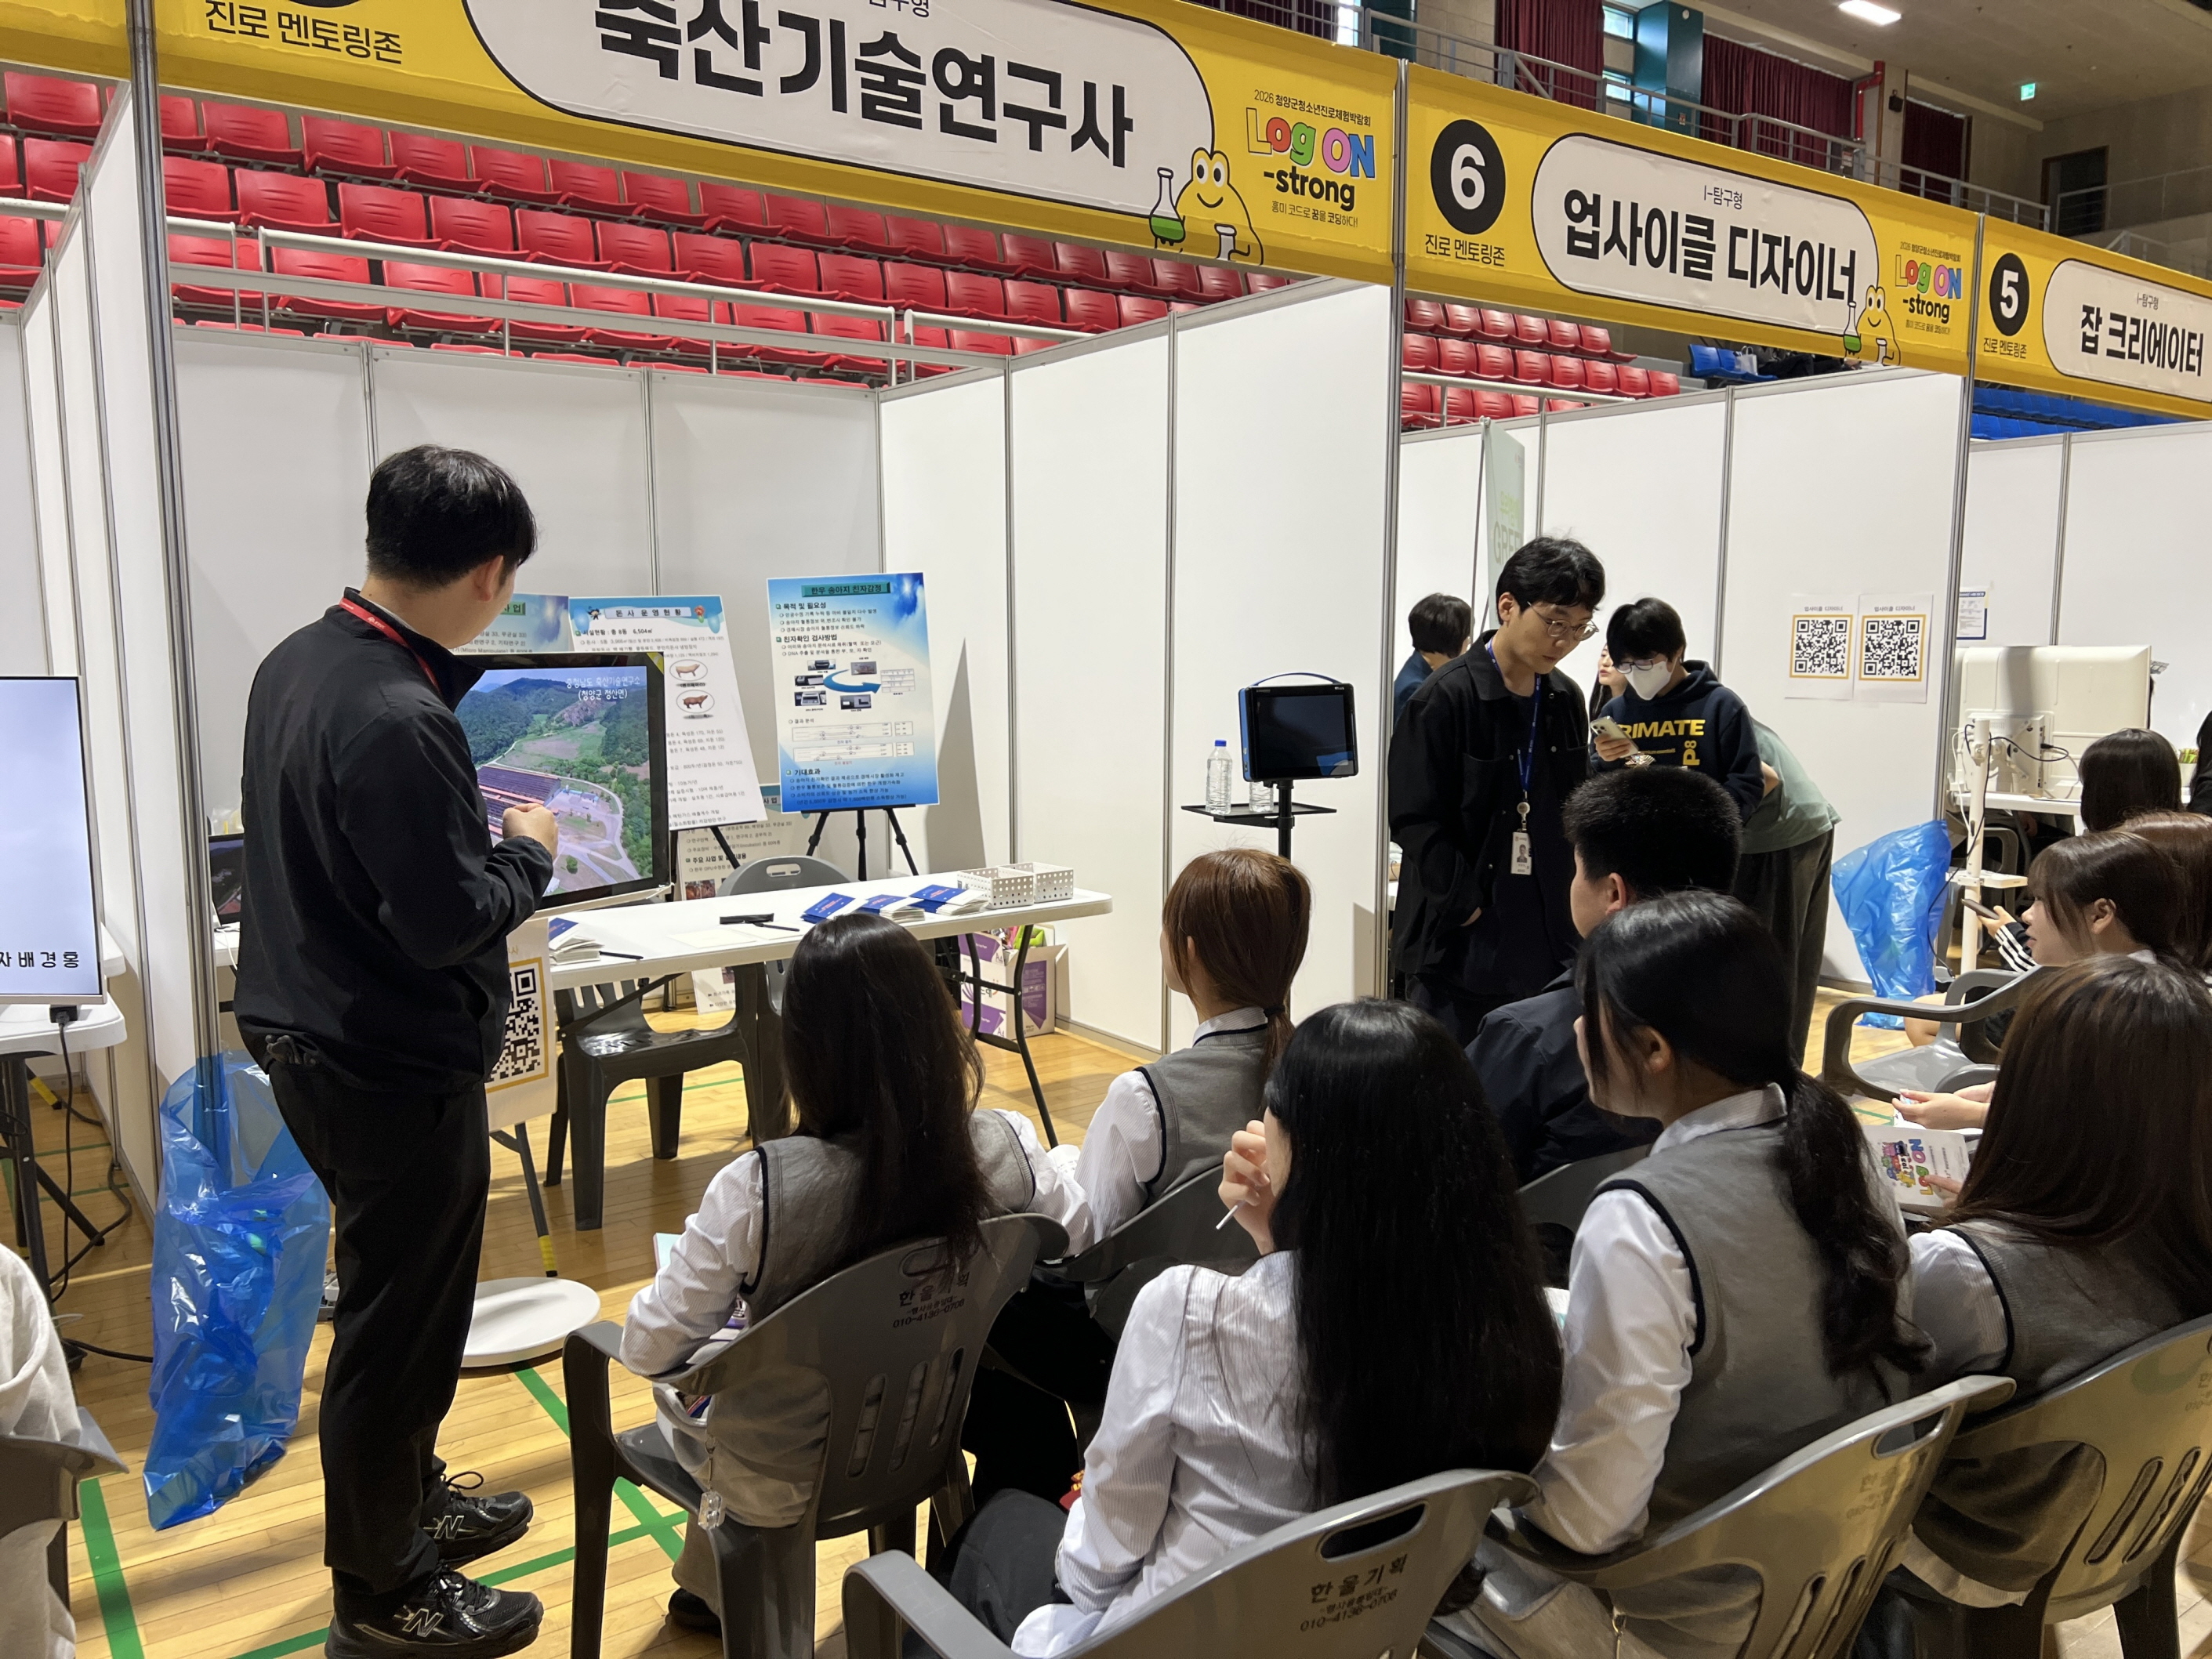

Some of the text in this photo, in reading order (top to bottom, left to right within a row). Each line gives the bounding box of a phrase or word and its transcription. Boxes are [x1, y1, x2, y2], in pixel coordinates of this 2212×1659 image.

[205, 0, 402, 64] 진로 멘토링존
[595, 0, 1133, 168] 축산기술연구사
[1254, 89, 1371, 127] 2026 청양군청소년진로체험박람회
[1246, 107, 1375, 179] Log ON
[1264, 165, 1354, 211] -strong
[1450, 143, 1485, 210] 6
[1271, 201, 1358, 227] 흥미 코드로 꿈을 코딩하다!
[1424, 234, 1505, 267] 진로 멘토링존
[1564, 190, 1856, 307] 업사이클 디자이너
[1895, 255, 1961, 299] Log ON
[1903, 294, 1949, 324] -strong
[2000, 270, 2018, 318] 5
[1984, 338, 2027, 359] 진로 멘토링존
[2081, 304, 2203, 377] 잡 크리에이터
[829, 585, 850, 594] 송아지
[566, 676, 640, 689] 충청남도 축산기술연구소
[578, 689, 627, 701] (청양군 정산면)
[1618, 719, 1706, 739] RIMATE
[995, 953, 1003, 963] A4
[1909, 1139, 1926, 1163] ON
[402, 1608, 444, 1638] N
